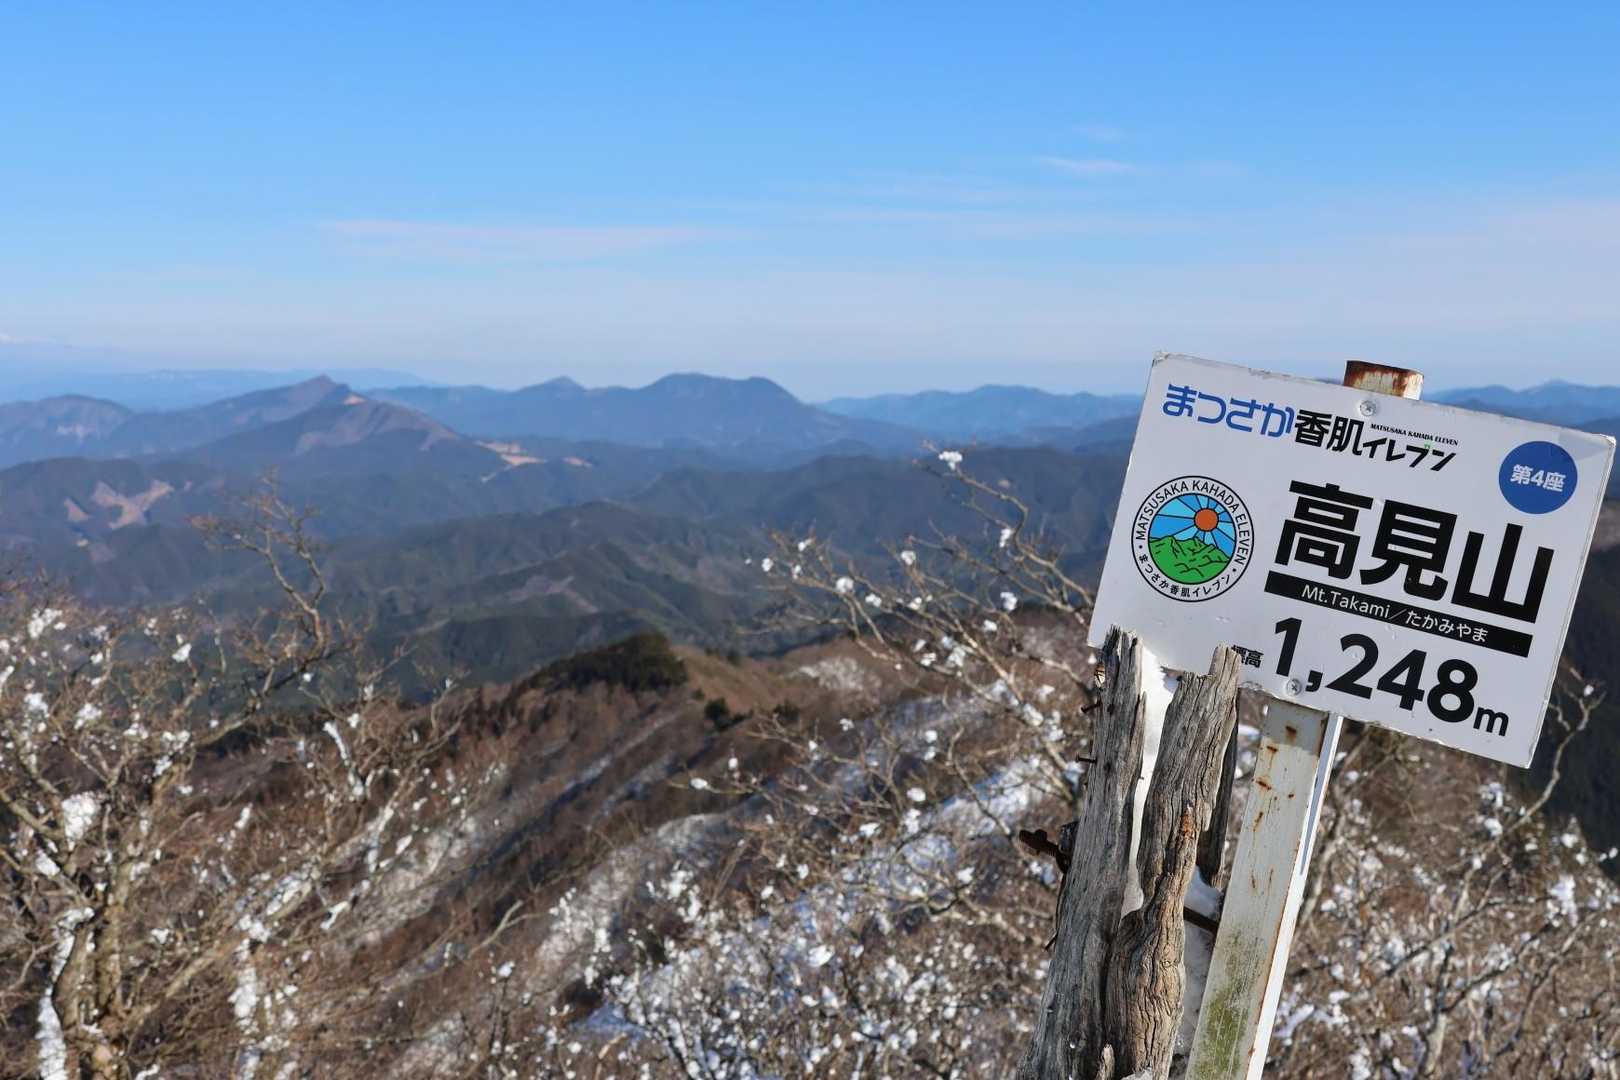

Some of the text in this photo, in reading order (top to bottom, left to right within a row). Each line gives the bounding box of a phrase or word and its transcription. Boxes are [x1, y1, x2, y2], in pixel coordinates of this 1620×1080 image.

[1370, 423, 1459, 446] MATSUSAKA KAHADA ELEVEN
[1509, 463, 1567, 493] 第4座
[1135, 480, 1250, 565] MATSUSAKA KAHADA ELEVEN
[1274, 480, 1556, 624] 高見山
[1138, 553, 1231, 598] まつさか香肌イレブン
[1274, 617, 1511, 737] 1,248m
